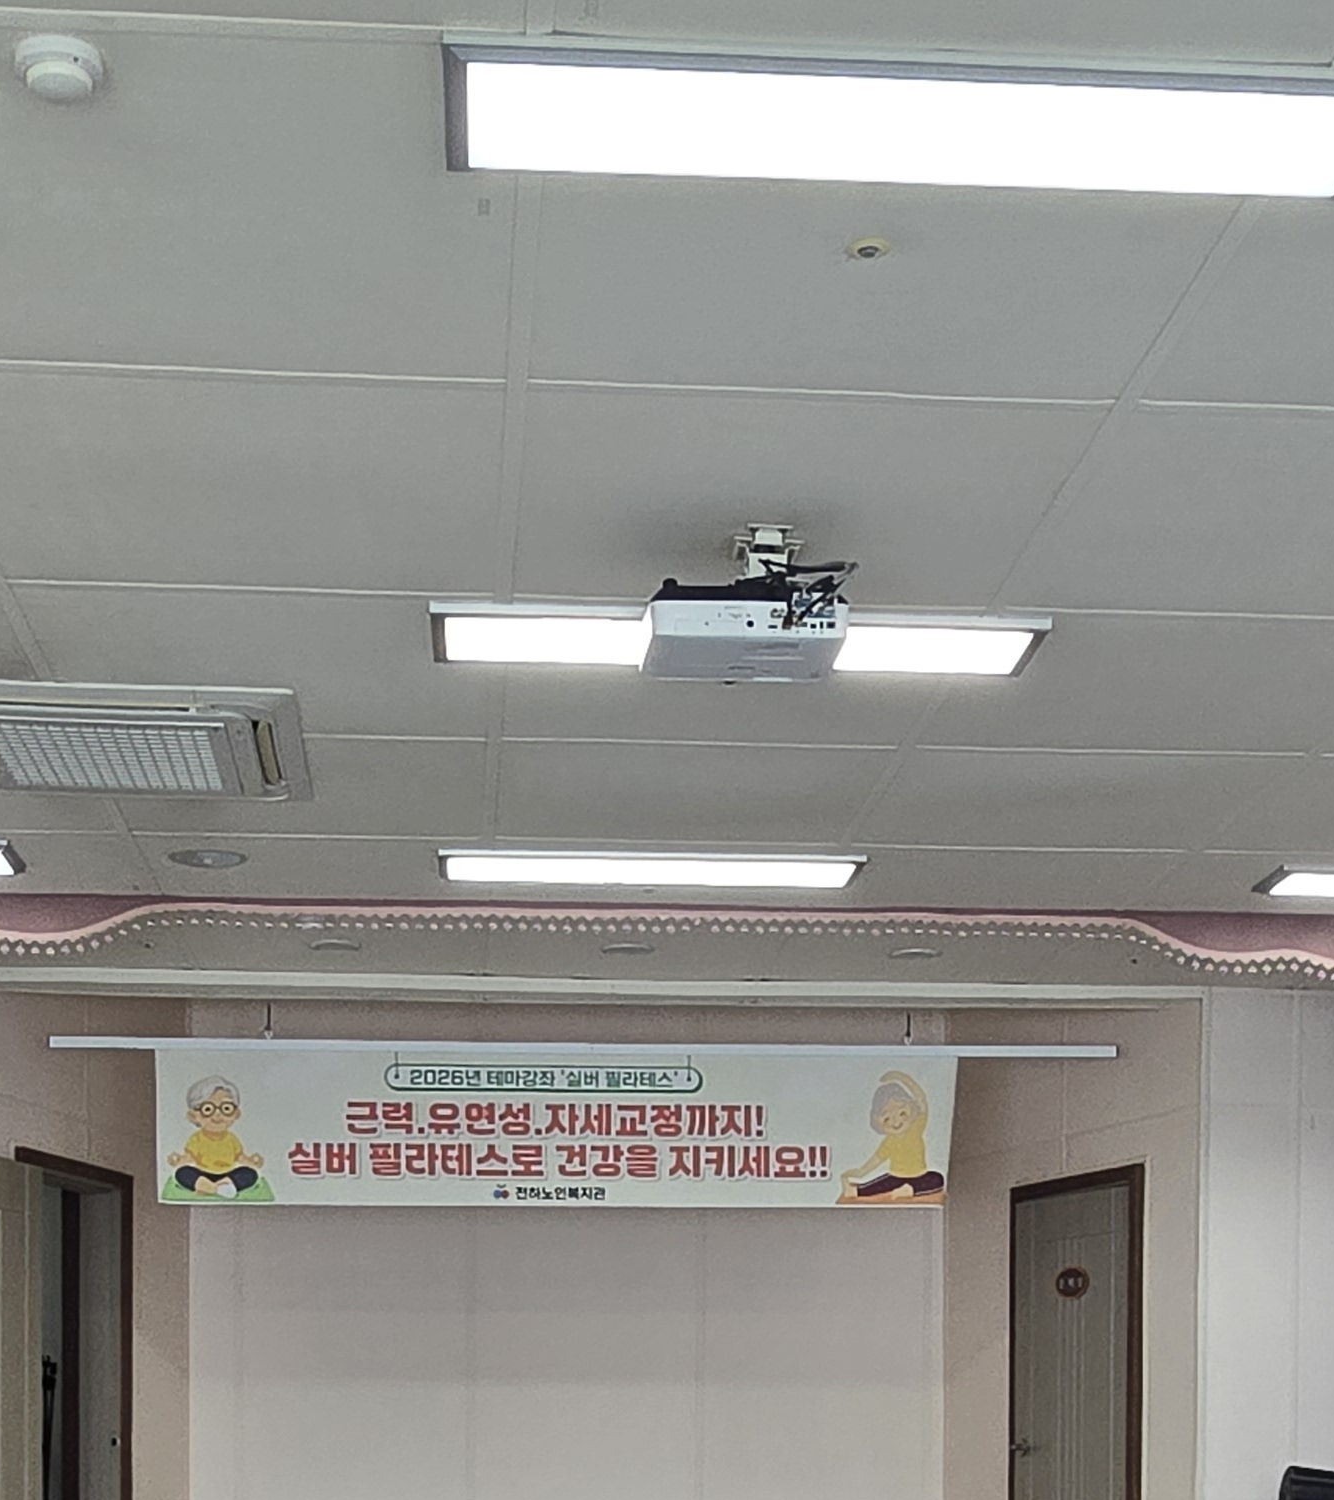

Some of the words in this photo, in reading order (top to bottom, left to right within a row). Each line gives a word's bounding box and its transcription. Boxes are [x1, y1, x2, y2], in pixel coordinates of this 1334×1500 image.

[409, 1069, 482, 1087] 2026년
[487, 1069, 555, 1088] 테마강좌
[288, 1142, 357, 1176] 실버
[369, 1143, 544, 1177] 필라테스로
[556, 1144, 659, 1178] 건강을
[669, 1145, 829, 1179] 지키세요!!
